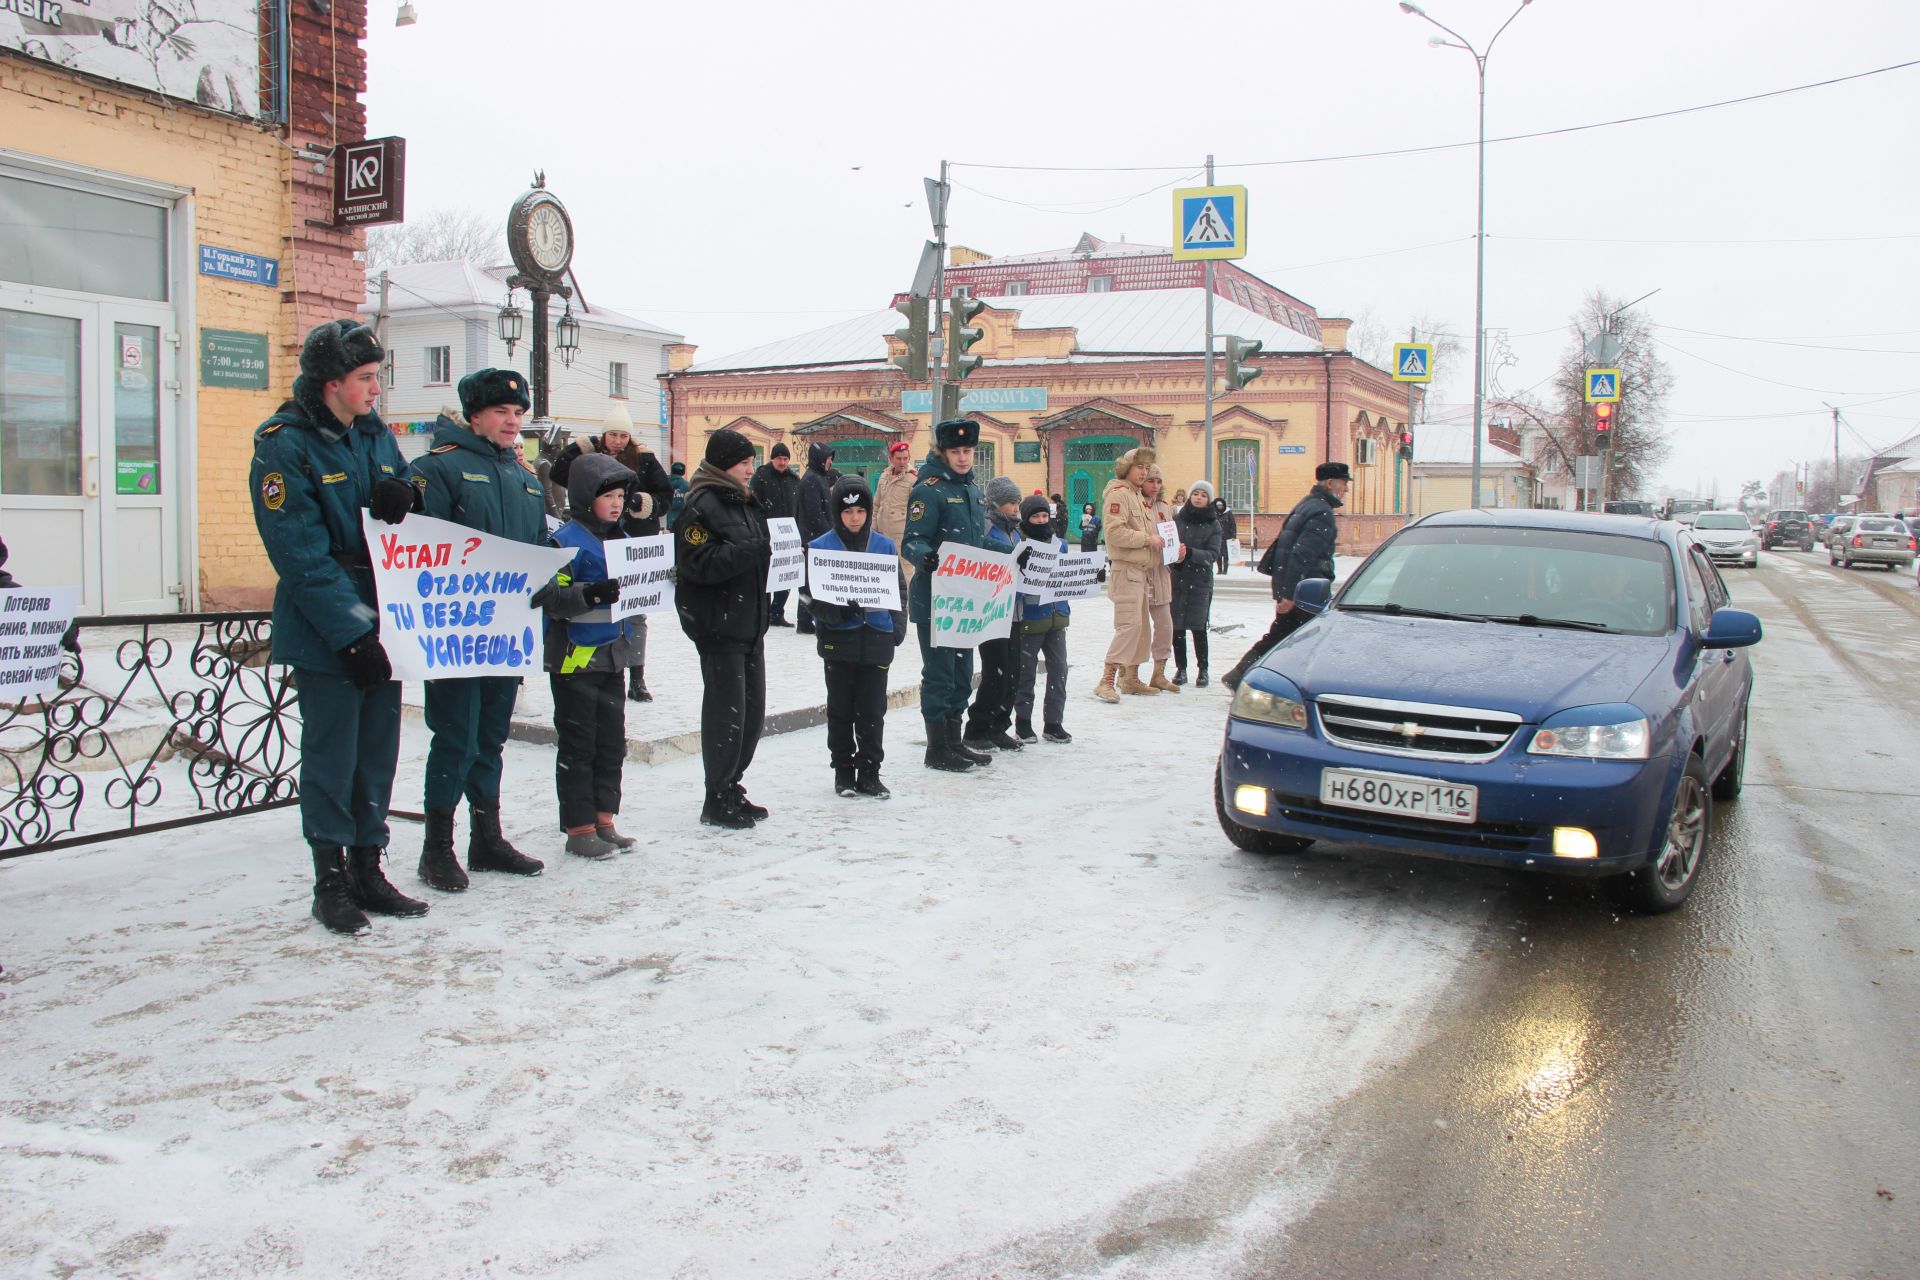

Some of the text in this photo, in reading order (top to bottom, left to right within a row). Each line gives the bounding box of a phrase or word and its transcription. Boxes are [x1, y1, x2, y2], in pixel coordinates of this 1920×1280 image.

[338, 200, 388, 215] КАРЛИНСКИЙ
[346, 213, 368, 221] МЯСНОЙ
[203, 248, 245, 264] М.Горький
[217, 261, 257, 277] М.Горького
[265, 263, 274, 280] 7
[212, 355, 231, 367] 7:00
[626, 544, 665, 562] Правила
[813, 556, 897, 573] Световозвращающие
[1059, 558, 1092, 567] Помните,
[641, 572, 648, 585] и
[830, 572, 880, 584] элементы не
[1049, 567, 1099, 579] каждая буква
[821, 583, 891, 596] только безопасно,
[1045, 577, 1098, 588] ПДД написана
[1054, 589, 1087, 598] кровью!
[4, 596, 51, 612] Потеряв
[620, 591, 661, 612] и ночью!
[422, 600, 496, 629] ВЕЗДЕ
[30, 619, 67, 636] можно
[418, 626, 534, 669] УСПЕЕШЬ!
[1431, 788, 1468, 808] 116
[1436, 806, 1457, 815] RUS
